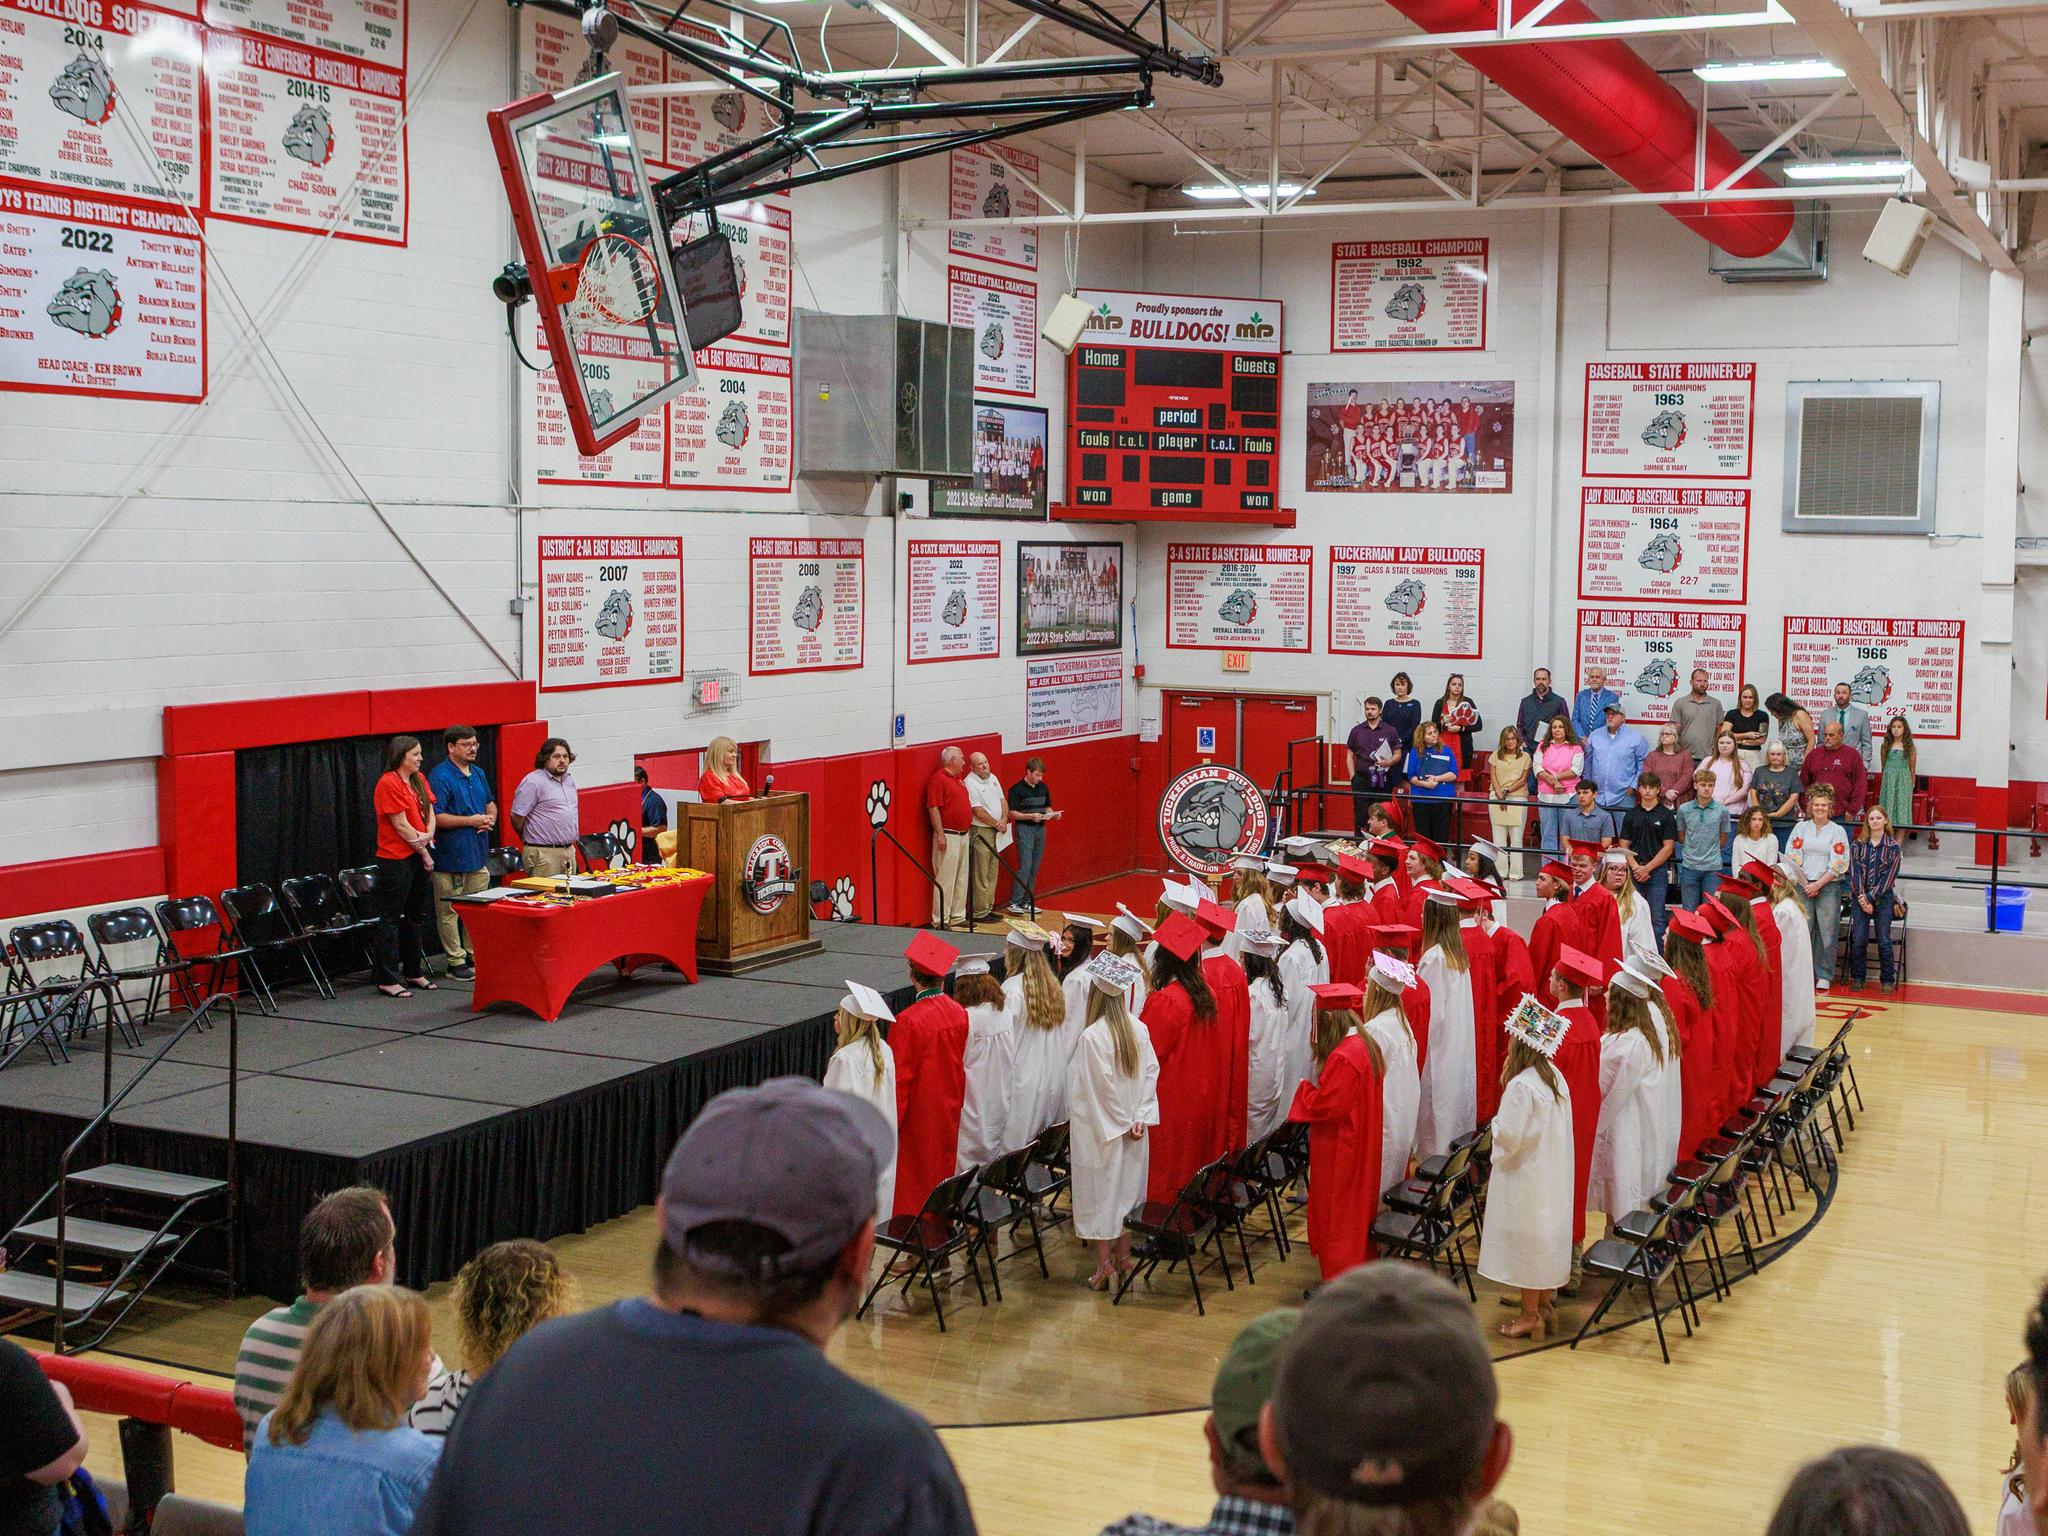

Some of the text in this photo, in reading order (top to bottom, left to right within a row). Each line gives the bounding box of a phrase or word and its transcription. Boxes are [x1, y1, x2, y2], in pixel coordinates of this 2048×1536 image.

[265, 44, 401, 99] CONFERENCE BASKETBALL CHAMPIONS
[67, 130, 102, 144] COACHES
[63, 141, 107, 156] MATT DILLON
[288, 180, 337, 196] CHAD SODEN
[24, 193, 72, 216] TENNIS
[73, 200, 129, 225] DISTRICT
[131, 210, 200, 236] CHAMPIONS
[61, 227, 113, 253] 2022
[3, 244, 27, 256] GATES
[1337, 240, 1482, 257] STATE BASEBALL CHAMPION
[126, 256, 159, 271] ANTHONY
[1396, 259, 1422, 268] 1992
[951, 269, 1034, 295] 2A STATE SOFTBALL CHAMPIONS
[1136, 302, 1223, 317] Proudly sponsors the
[1129, 318, 1230, 343] BULLDOGS!
[711, 350, 724, 366] EAST
[726, 351, 759, 370] BASKETBALL
[761, 357, 790, 374] CHAMPIONS
[1085, 350, 1119, 366] Home
[1234, 357, 1275, 374] Guests
[38, 358, 60, 370] HEAD
[62, 361, 88, 372] COACH
[95, 362, 111, 374] KEN
[112, 365, 142, 377] BROWN
[582, 362, 610, 380] 2005
[1589, 364, 1752, 379] BASEBALL STATE RUNNER-UP
[720, 379, 745, 394] 2004
[1632, 384, 1706, 392] DISTRICT CHAMPIONS
[1654, 394, 1684, 405] 1963
[1160, 409, 1197, 424] period
[1081, 432, 1109, 446] fouls
[1119, 434, 1144, 447] t.o.l.
[1158, 434, 1197, 449] player
[1211, 438, 1235, 451] t.o.l.
[1245, 438, 1272, 452] fouls
[947, 491, 1033, 511] 2021 2A State Softball Champions
[1083, 489, 1106, 502] won
[1162, 490, 1191, 506] game
[1247, 494, 1269, 506] won
[1585, 489, 1745, 505] LADY BULLDOG BASKETBALL STATE RUNNER-UP
[1668, 507, 1699, 515] CHAMPS
[1649, 518, 1678, 530] 1964
[543, 539, 574, 556] DISTRICT
[594, 539, 609, 556] EAST
[611, 539, 642, 556] BASEBALL
[644, 539, 678, 555] CHAMPIONS
[911, 544, 998, 555] 2A STATE SOFTBALL CHAMPIONS
[1170, 547, 1311, 563] 3-A STATE BASKETBALL RUNNER-UP
[1334, 547, 1481, 563] TUCKERMAN LADY BULLDOGS
[799, 563, 819, 576] 2008
[949, 560, 963, 569] 2022
[1337, 566, 1356, 575] 1997
[1364, 566, 1383, 574] CLASS
[1455, 569, 1475, 578] 1998
[547, 573, 583, 583] DANNY ADAMS
[600, 566, 628, 581] 2007
[1680, 576, 1698, 585] 22-7
[548, 587, 584, 597] HUNTER GATES
[559, 615, 576, 625] GREEN
[1582, 611, 1741, 630] LADY BULLDOG BASKETBALL STATE RUNNER-UP
[1788, 618, 1960, 637] LADY BULLDOG BASKETBALL STATE RUNNER-UP
[1026, 627, 1114, 645] 2022 2A State Softball Champions
[1627, 630, 1693, 639] DISTRICT CHAMPS
[1644, 641, 1673, 653] 1965
[1837, 638, 1908, 647] DISTRICT CHAMPS
[1857, 647, 1887, 659] 1966
[1029, 664, 1049, 675] WELCOME
[1055, 661, 1087, 673] TUCKERMAN
[1089, 660, 1100, 670] HIGH
[1102, 658, 1120, 668] SCHOOL
[1227, 654, 1246, 668] EXIT
[1029, 679, 1038, 687] WE
[1924, 682, 1952, 691] MARY HOLT
[703, 682, 719, 703] EXIT
[1164, 770, 1264, 827] TUCKERMAN BULLDOGS
[1168, 836, 1180, 855] PRIDE
[1185, 857, 1218, 872] TRADITION
[1249, 839, 1260, 854] 1903
[760, 851, 783, 883] T
